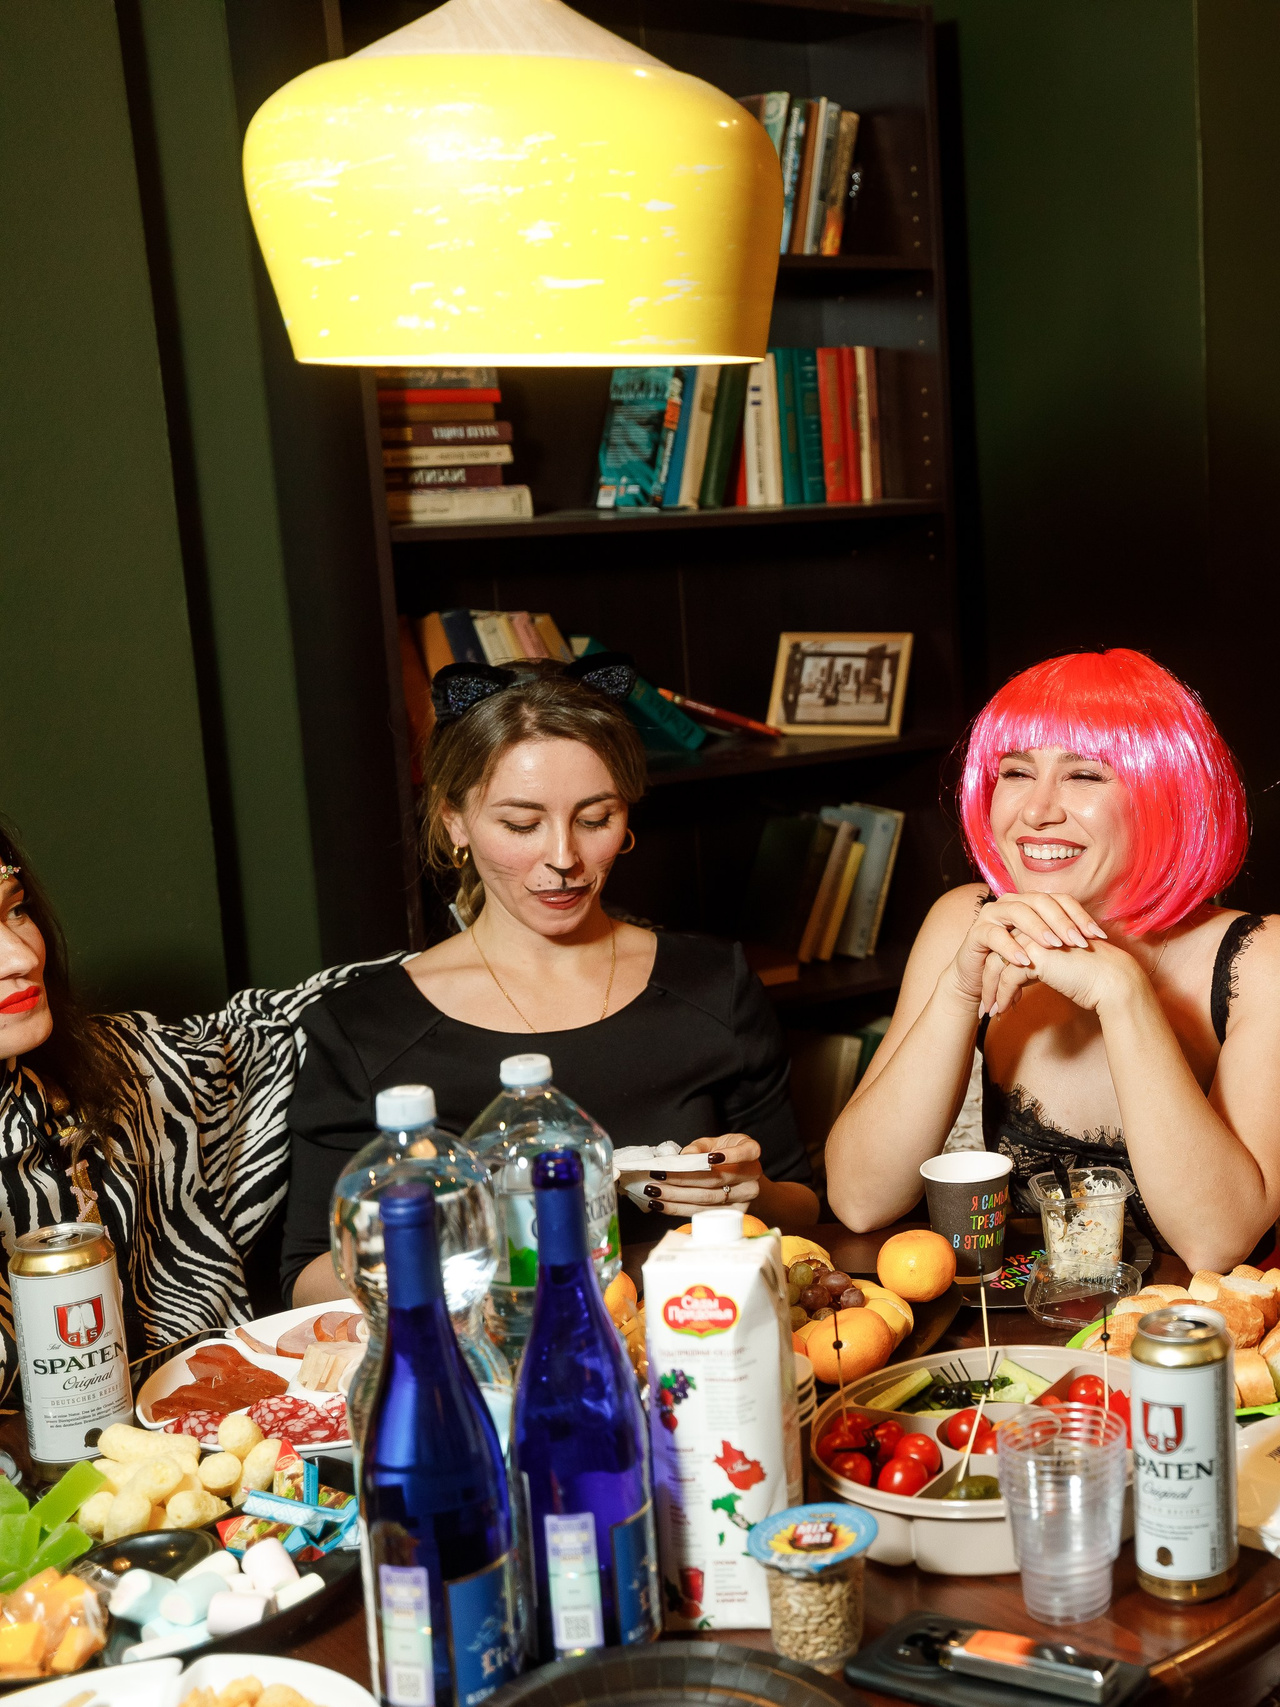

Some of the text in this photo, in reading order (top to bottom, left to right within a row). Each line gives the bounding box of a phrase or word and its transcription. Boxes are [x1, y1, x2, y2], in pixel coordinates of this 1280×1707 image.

[970, 1195, 979, 1212] Я
[953, 1233, 961, 1249] В
[963, 1232, 994, 1250] ЭТОМ
[32, 1337, 125, 1375] SPATEN
[62, 1365, 115, 1391] Original
[50, 1394, 96, 1406] DEUTSCHES
[1133, 1451, 1216, 1481] PATEN
